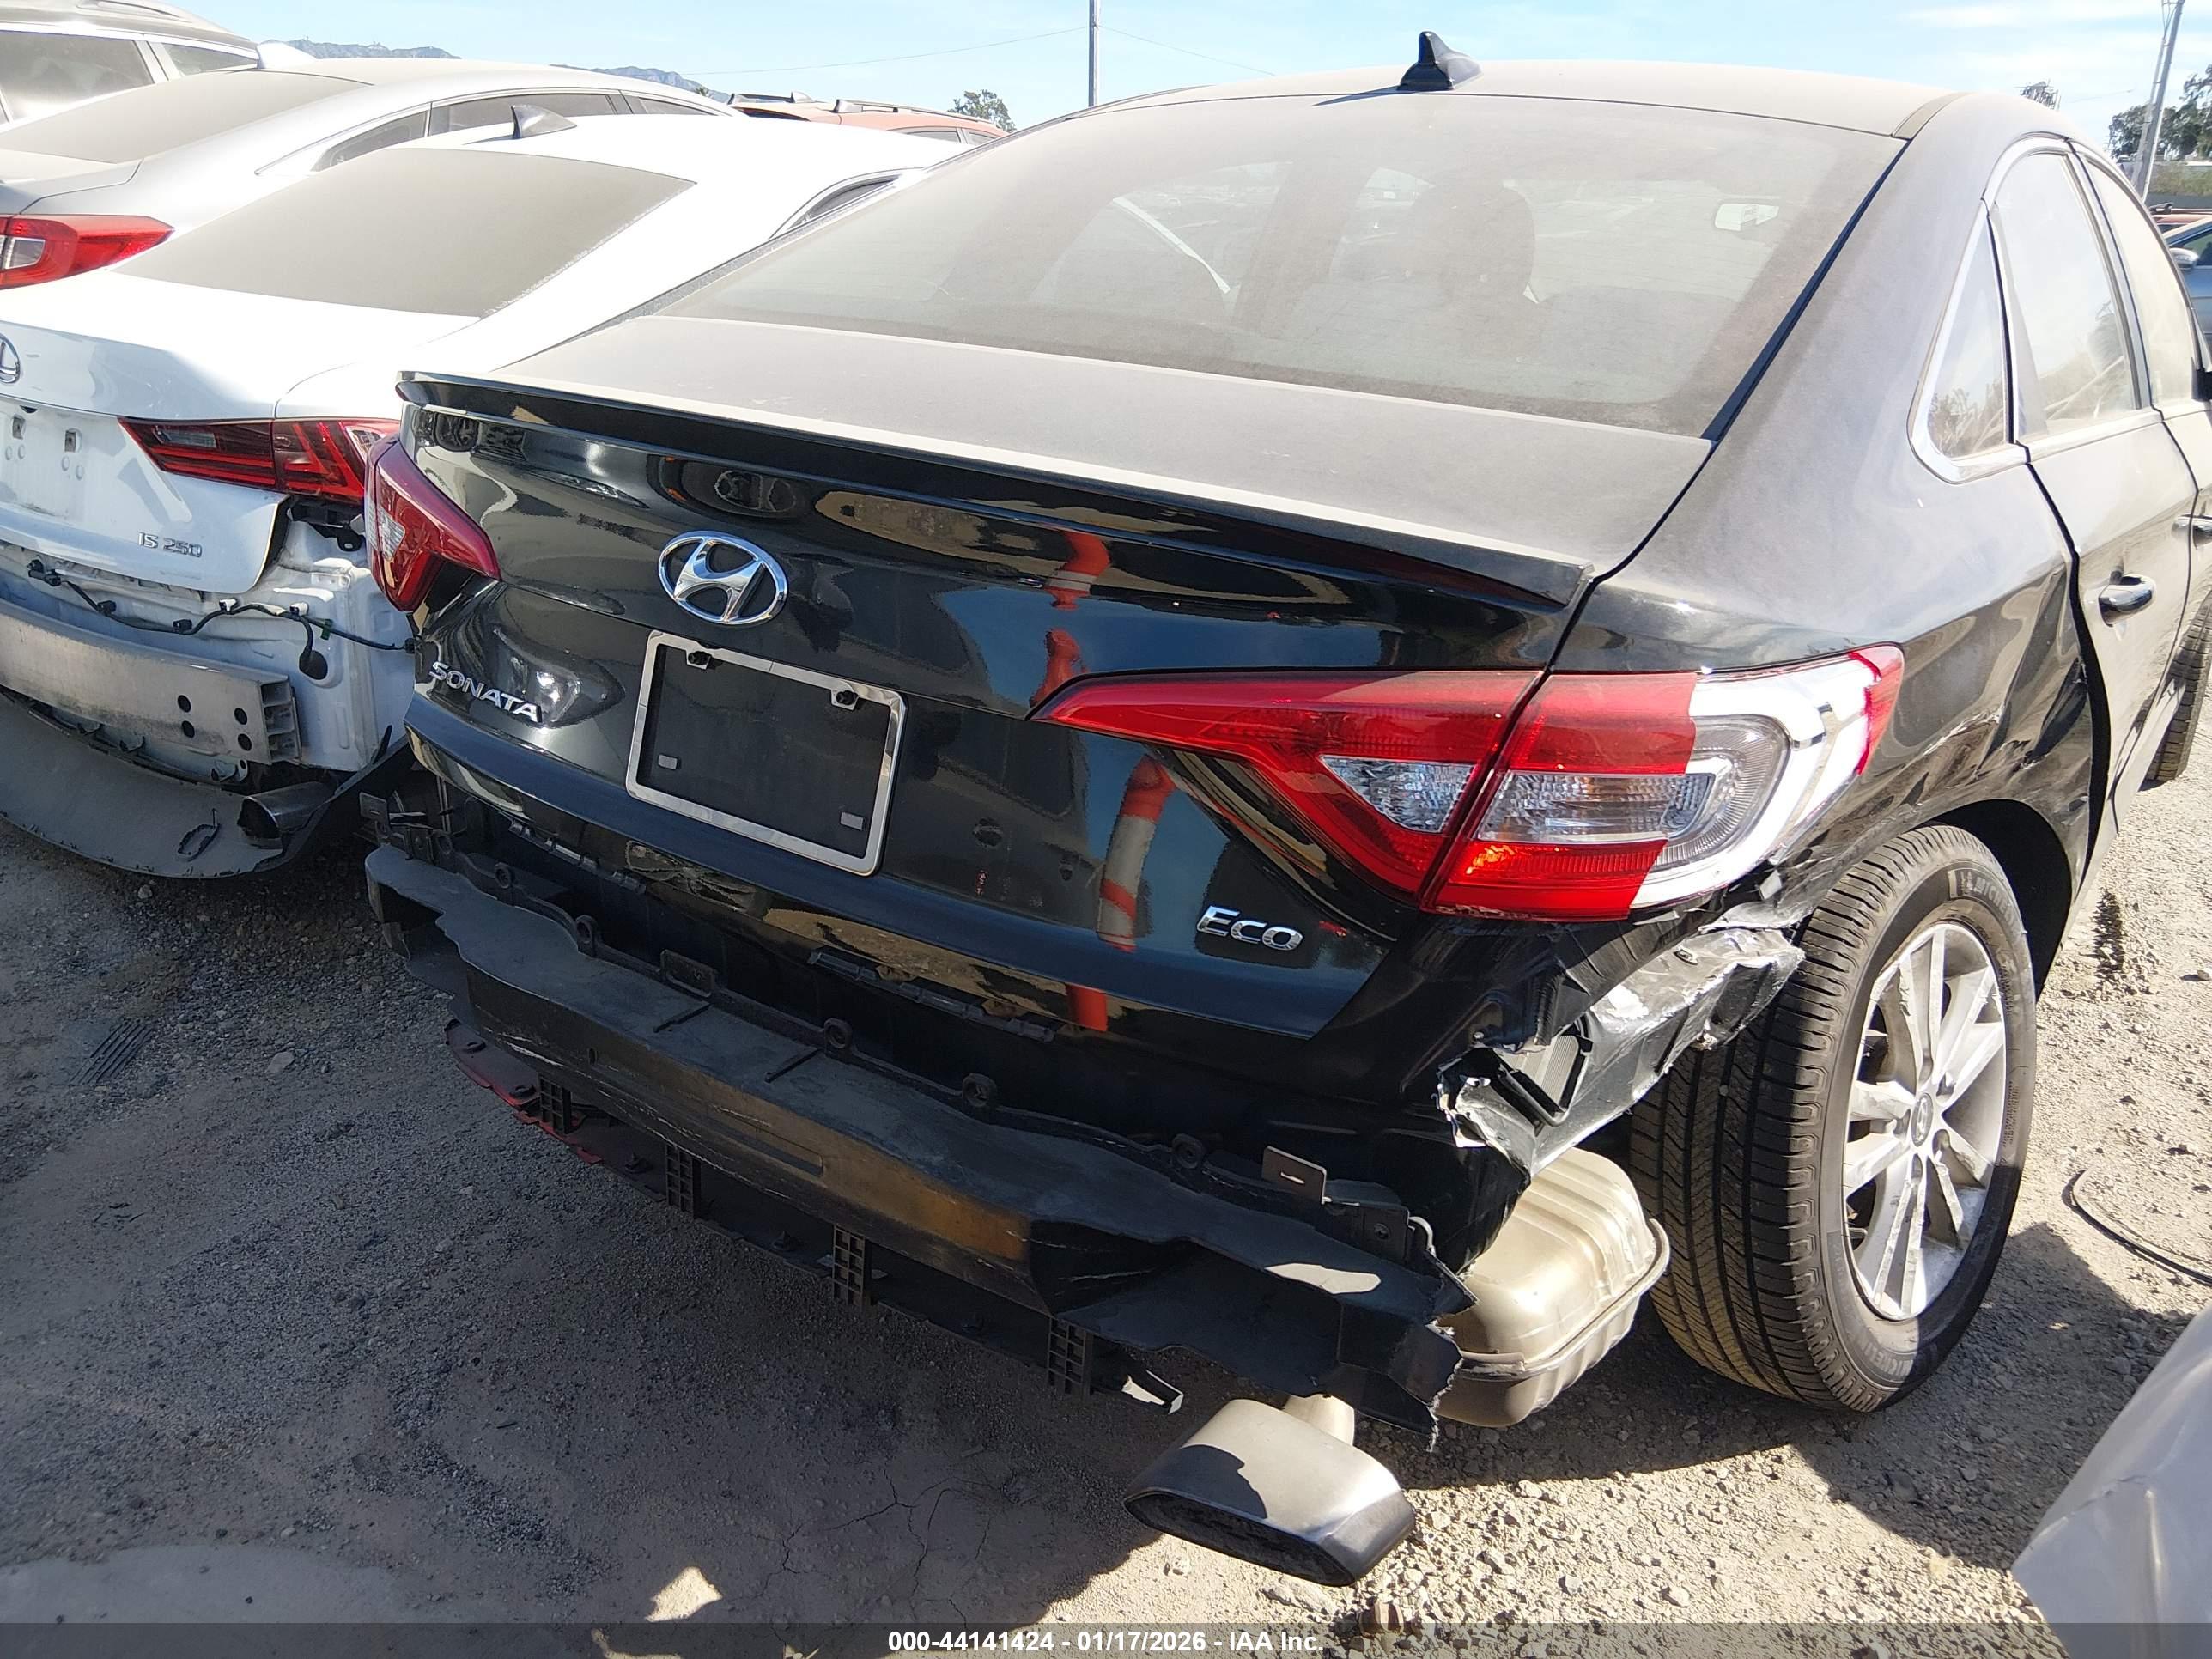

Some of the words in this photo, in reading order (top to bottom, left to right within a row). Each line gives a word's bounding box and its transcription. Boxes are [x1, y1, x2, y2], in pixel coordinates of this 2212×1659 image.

[138, 532, 158, 549] IS
[163, 538, 203, 558] 250
[429, 661, 543, 723] SONATA
